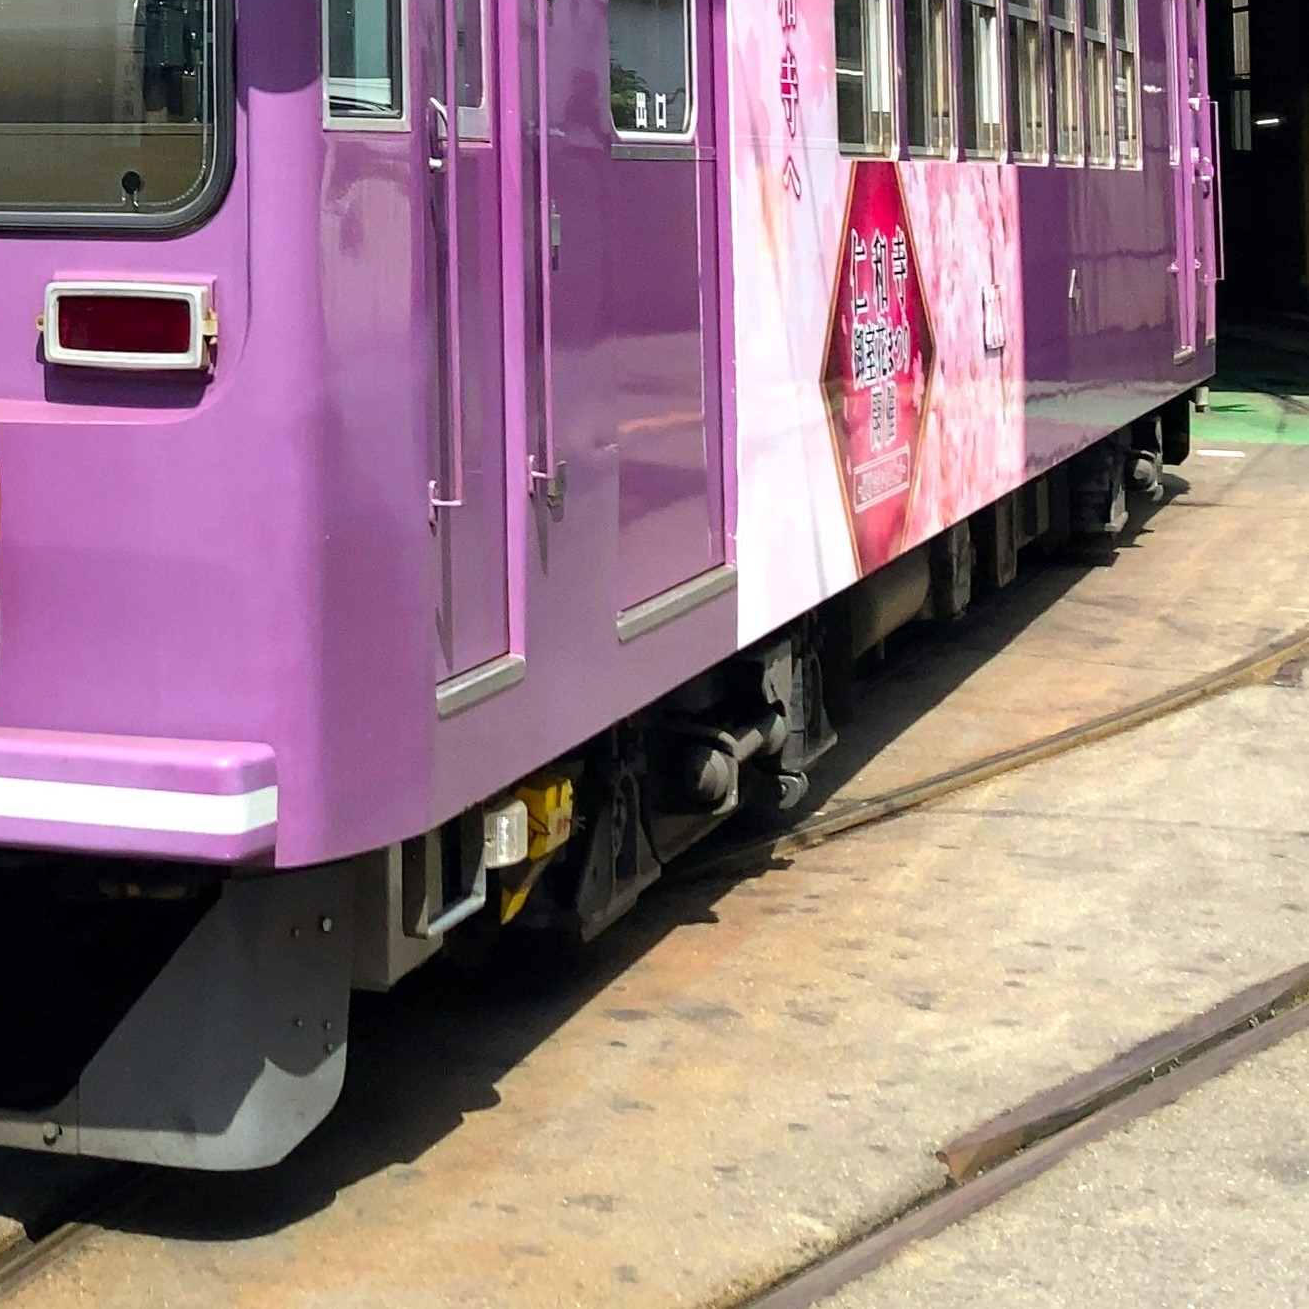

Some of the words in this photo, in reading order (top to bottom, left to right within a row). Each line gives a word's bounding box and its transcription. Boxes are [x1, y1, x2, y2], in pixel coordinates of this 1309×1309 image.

[636, 92, 667, 129] 出口
[850, 226, 907, 313] 仁和寺
